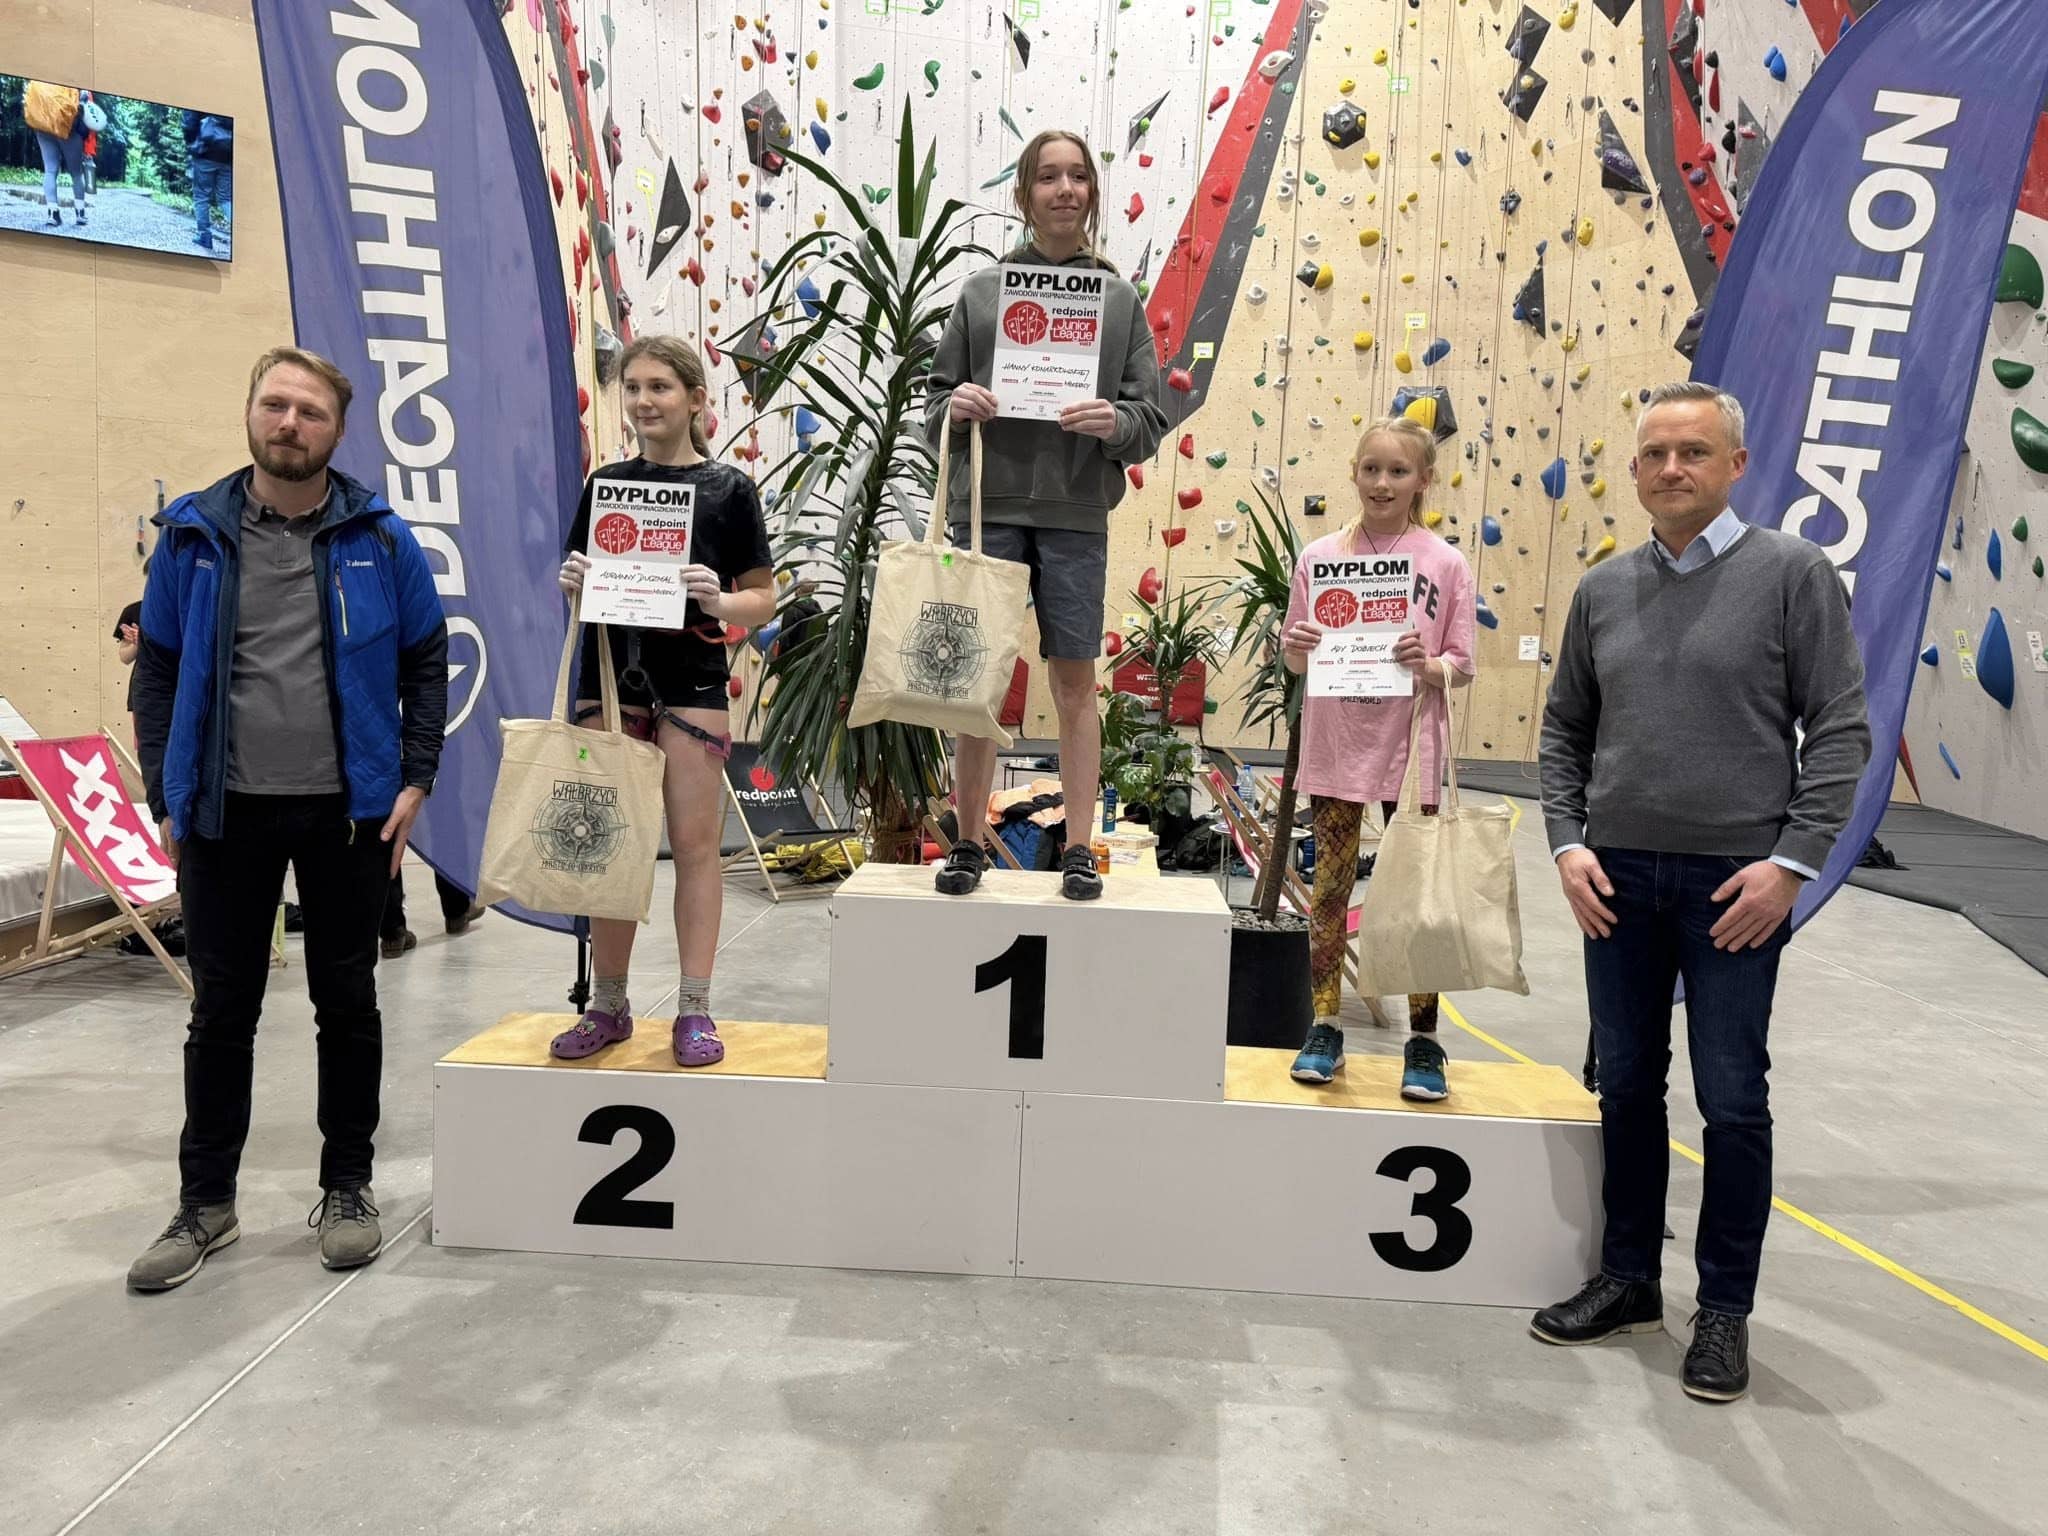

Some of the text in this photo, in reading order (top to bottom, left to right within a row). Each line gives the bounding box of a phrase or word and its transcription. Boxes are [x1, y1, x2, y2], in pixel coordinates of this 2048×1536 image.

[1005, 271, 1102, 294] DYPLOM
[1004, 288, 1102, 303] ZAWODÓW WSPINACZKOWYCH
[1052, 306, 1098, 319] redpoint
[1057, 319, 1091, 331] Junior
[1053, 328, 1093, 342] League
[1781, 89, 1961, 592] CATHLON
[598, 486, 690, 506] DYPLOM
[642, 517, 687, 530] redpoint
[647, 529, 680, 541] Junior
[643, 538, 682, 552] League
[1313, 560, 1409, 579] DYPLOM
[1312, 577, 1410, 587] ZAWODÓW WSPINACZKOWYCH
[1361, 587, 1407, 599] redpoint
[1412, 572, 1440, 622] FE
[1367, 600, 1401, 610] Junior
[1364, 608, 1404, 621] League
[552, 782, 618, 806] WAŁBRZYCH
[735, 787, 798, 803] redpoint
[975, 934, 1047, 1059] 1
[573, 1104, 677, 1229] 2
[1368, 1145, 1474, 1273] 3
